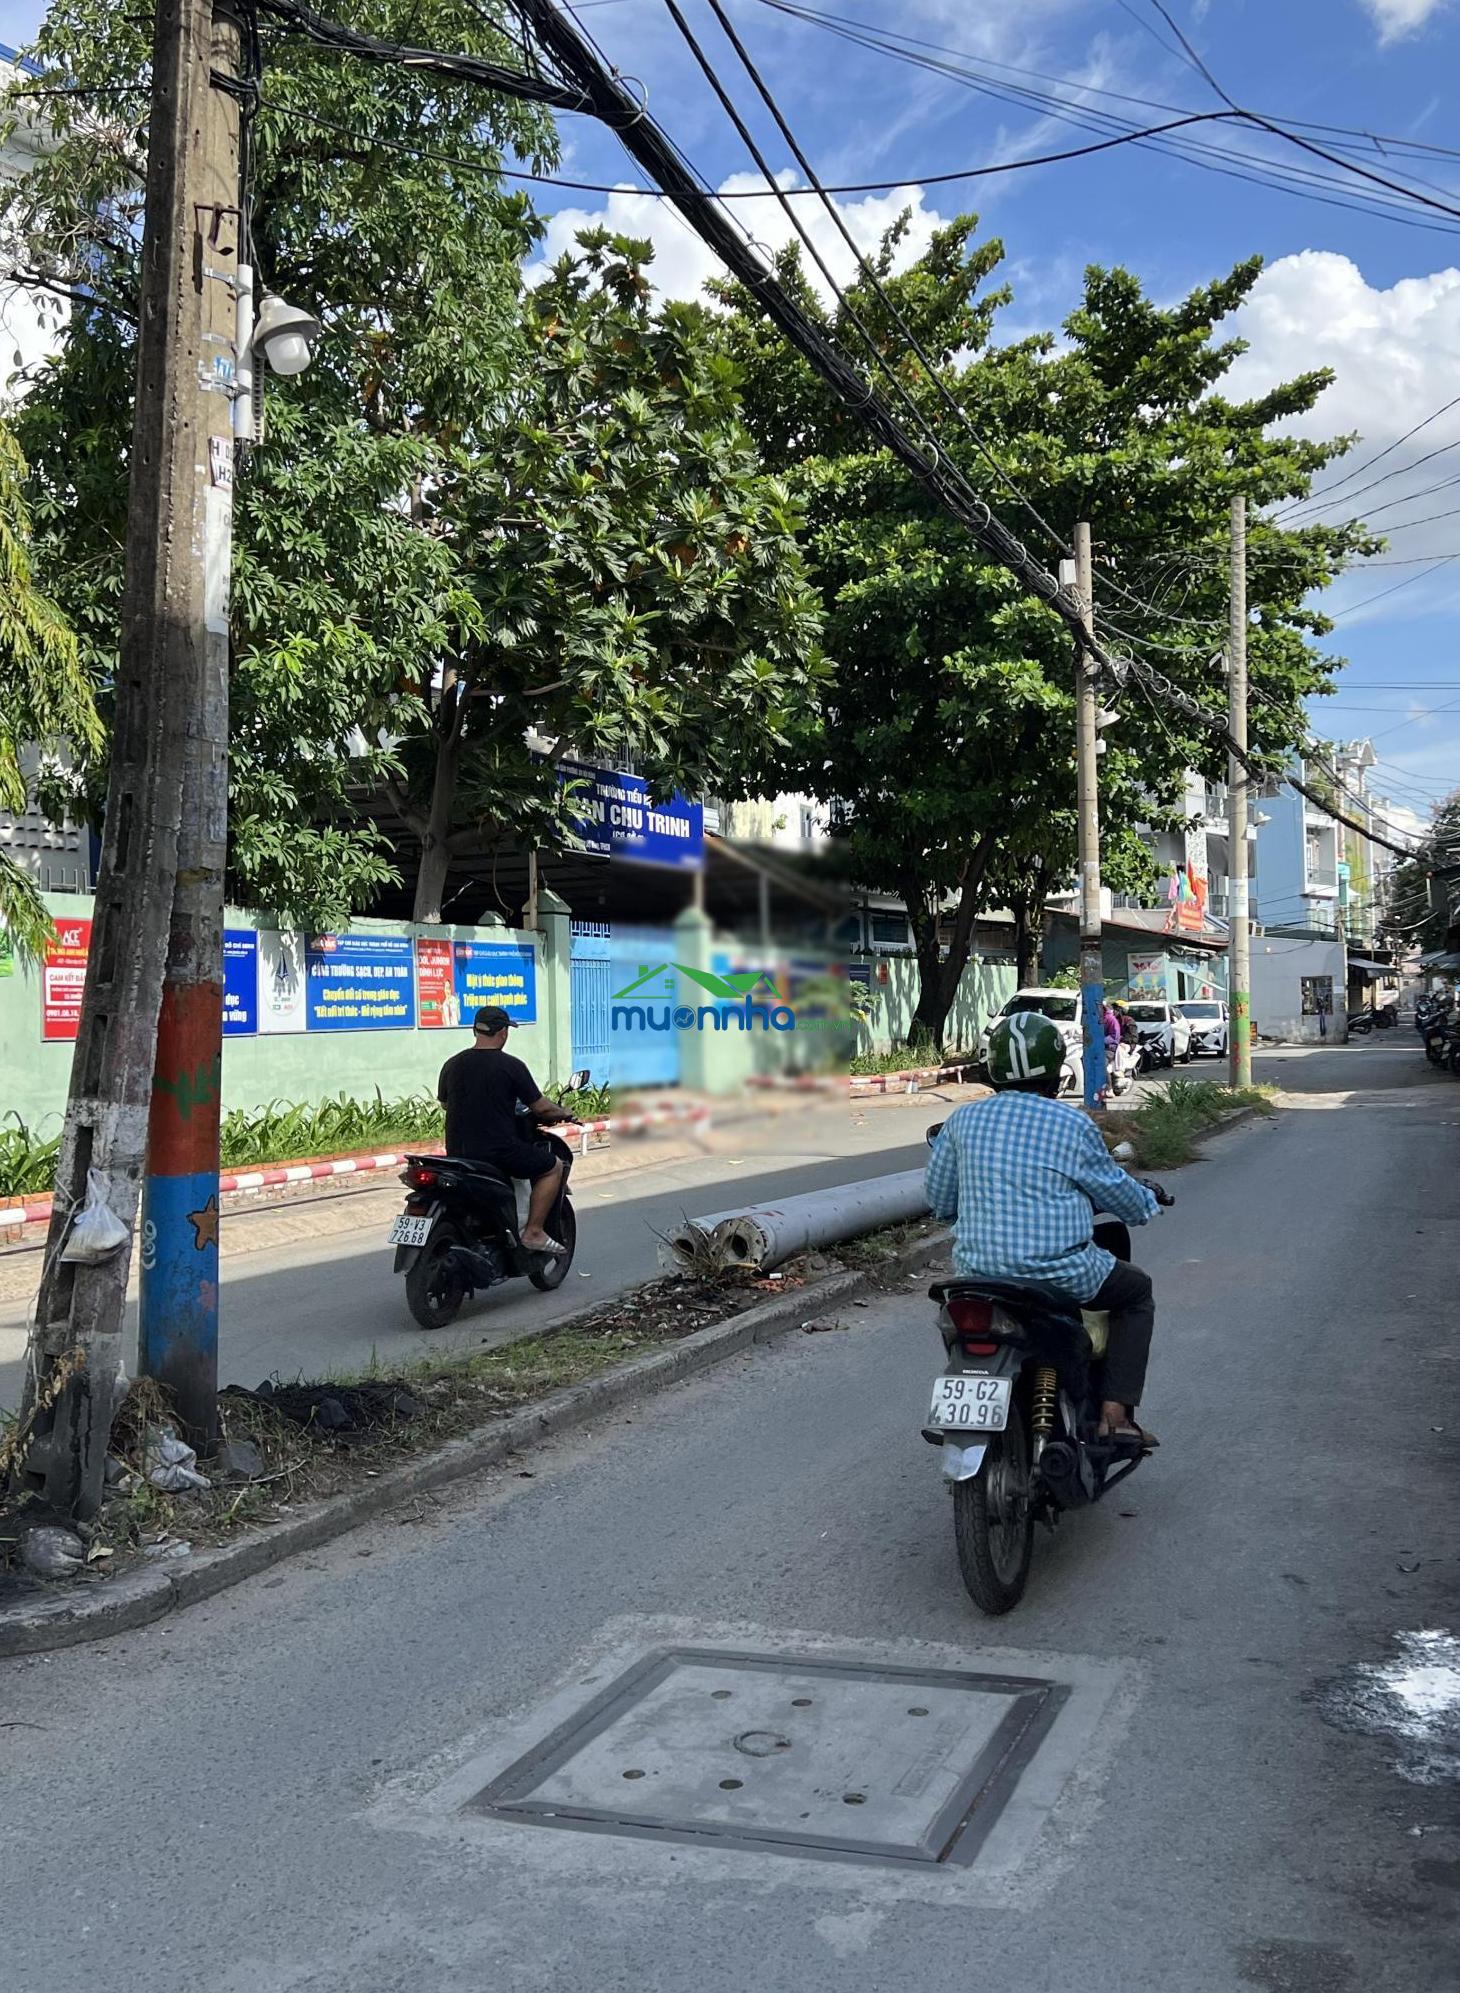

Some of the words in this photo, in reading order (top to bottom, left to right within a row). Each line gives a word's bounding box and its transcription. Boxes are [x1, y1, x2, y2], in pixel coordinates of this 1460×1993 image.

[610, 804, 643, 829] CHU
[647, 811, 690, 838] TRINH
[398, 1217, 426, 1231] 59-V3
[942, 1379, 999, 1401] 59-G2
